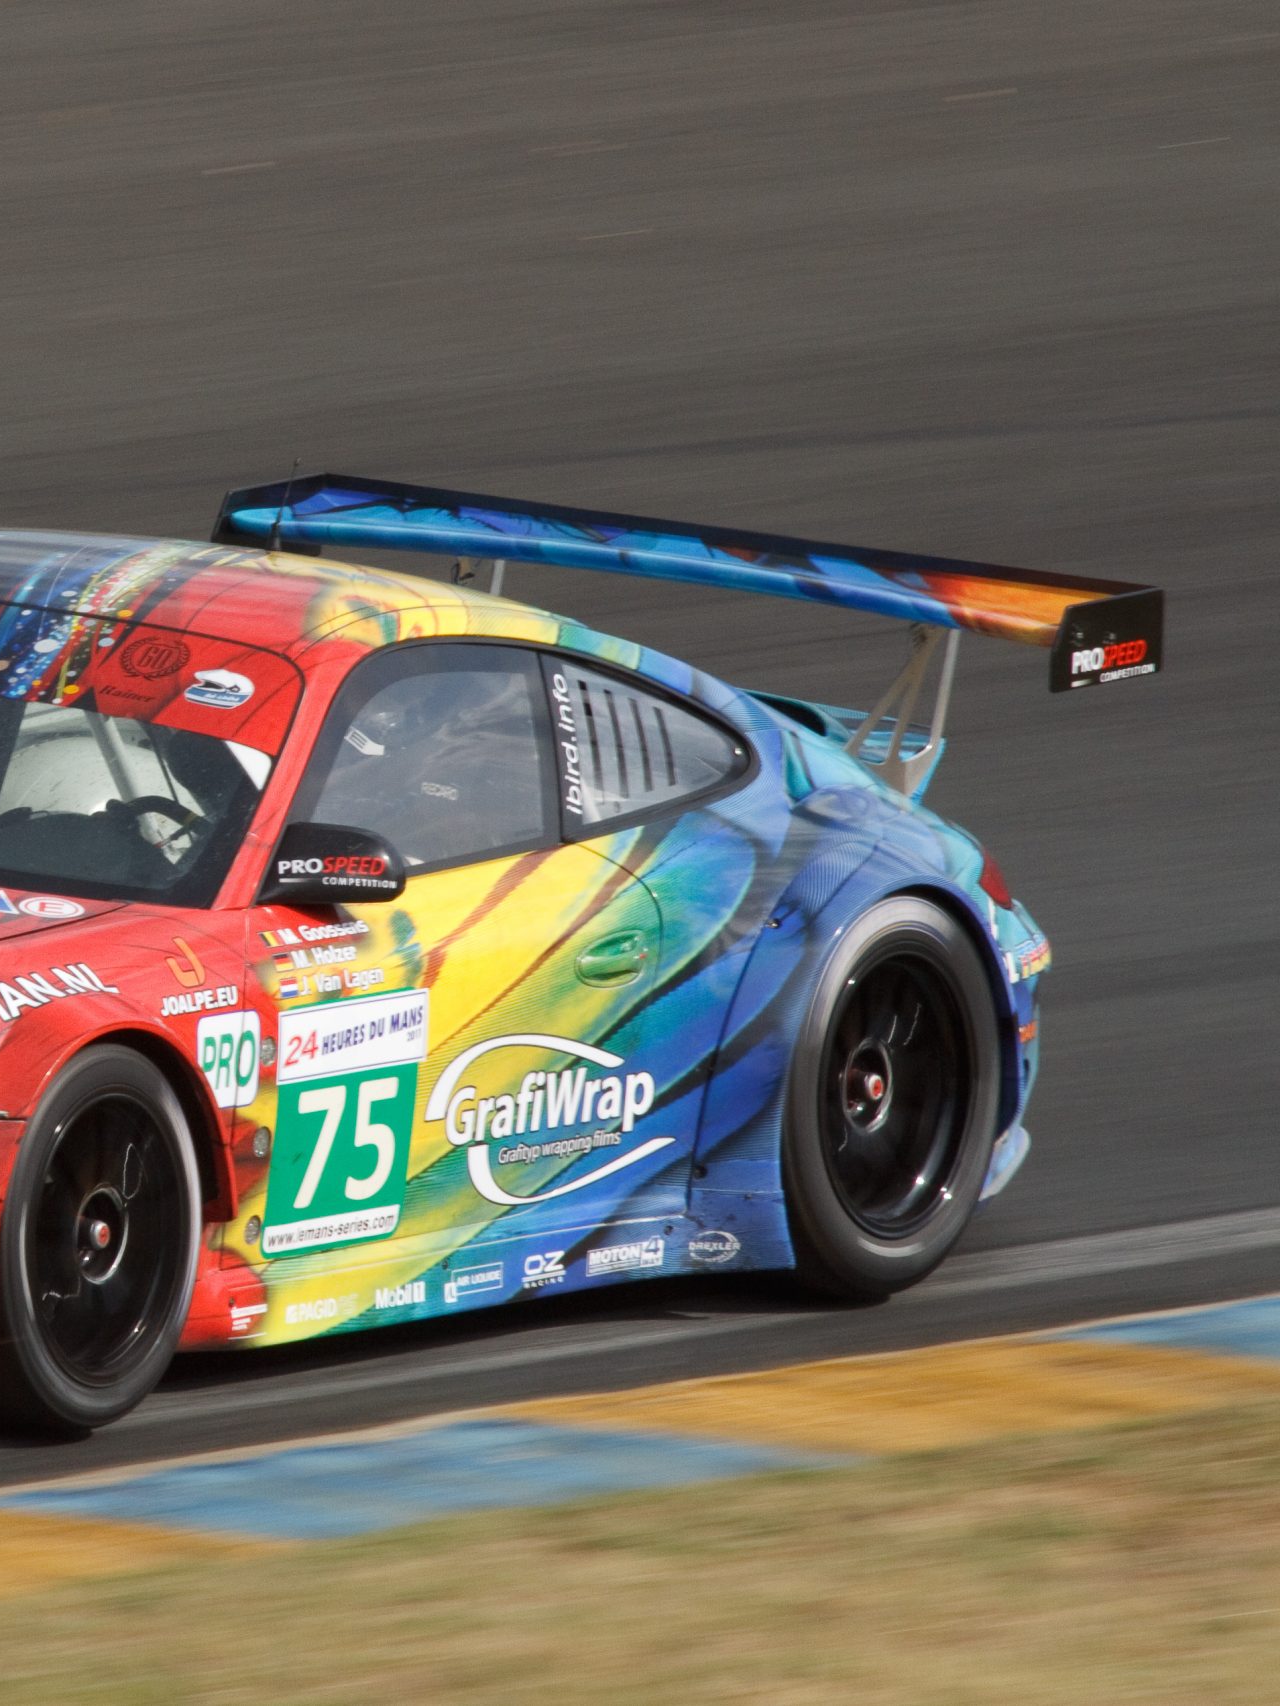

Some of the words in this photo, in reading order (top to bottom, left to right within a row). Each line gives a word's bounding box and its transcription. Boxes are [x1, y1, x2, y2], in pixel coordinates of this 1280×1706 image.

[1071, 640, 1147, 674] PROSPEED
[278, 855, 385, 876] PROSPEED
[322, 877, 397, 889] COMPETITION
[298, 920, 369, 942] Goossens
[290, 950, 312, 969] M.
[311, 945, 357, 966] Holzer
[299, 976, 311, 996] J.
[314, 973, 341, 993] Van
[344, 968, 384, 991] Lagen
[161, 985, 238, 1017] JOALPE.EU
[284, 1030, 319, 1067] 24
[321, 1023, 365, 1055] HEURES
[370, 1017, 385, 1040] DU
[389, 1005, 423, 1034] MANS
[203, 1030, 256, 1088] PRO
[445, 1067, 655, 1146] GrafiWrap
[293, 1076, 399, 1209] 75
[541, 1136, 592, 1158] wrapping
[592, 1130, 621, 1148] films
[267, 1213, 395, 1247] www.lemans-series.com
[589, 1245, 641, 1266] MOTON
[688, 1241, 741, 1252] DREXLER
[524, 1250, 565, 1276] OZ
[375, 1283, 413, 1310] Mobil
